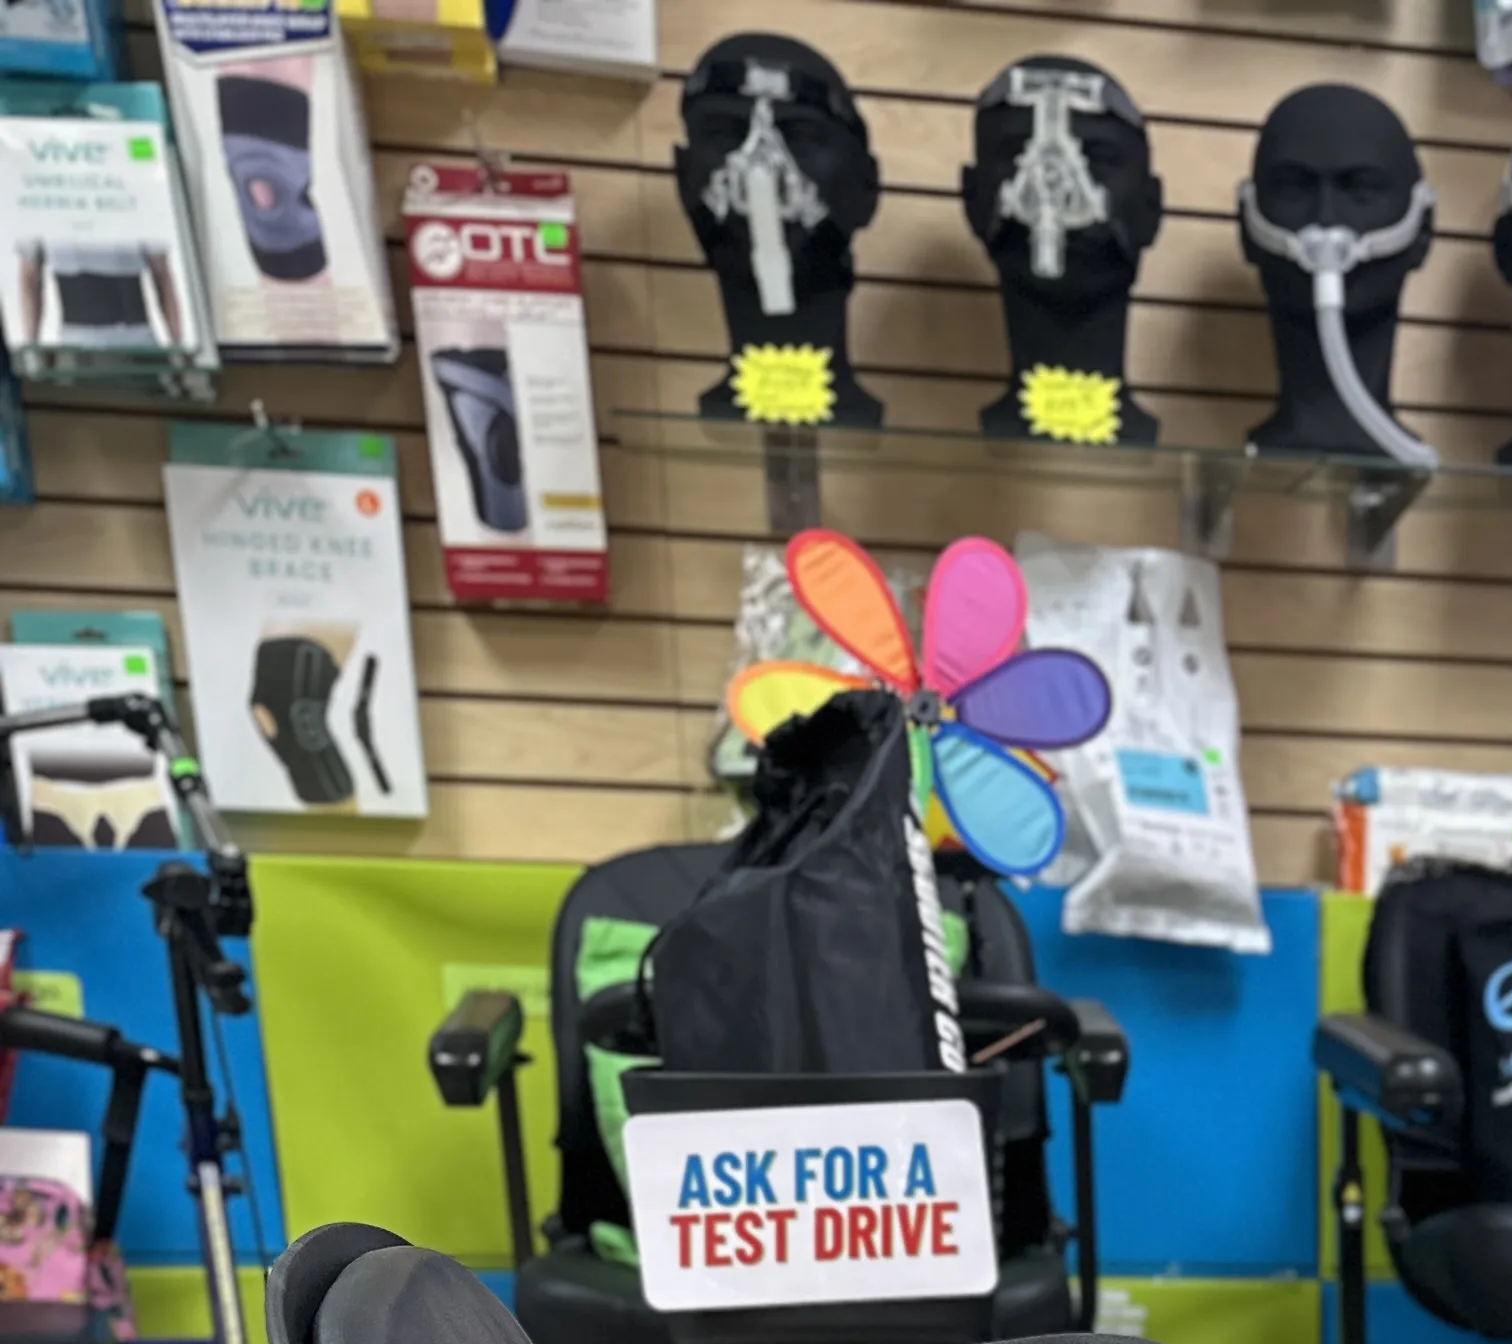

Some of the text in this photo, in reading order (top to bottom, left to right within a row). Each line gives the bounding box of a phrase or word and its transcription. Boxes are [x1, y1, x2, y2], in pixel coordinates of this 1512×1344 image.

[678, 1143, 937, 1208] ASK FOR A
[669, 1202, 960, 1269] TEST DRIVE
